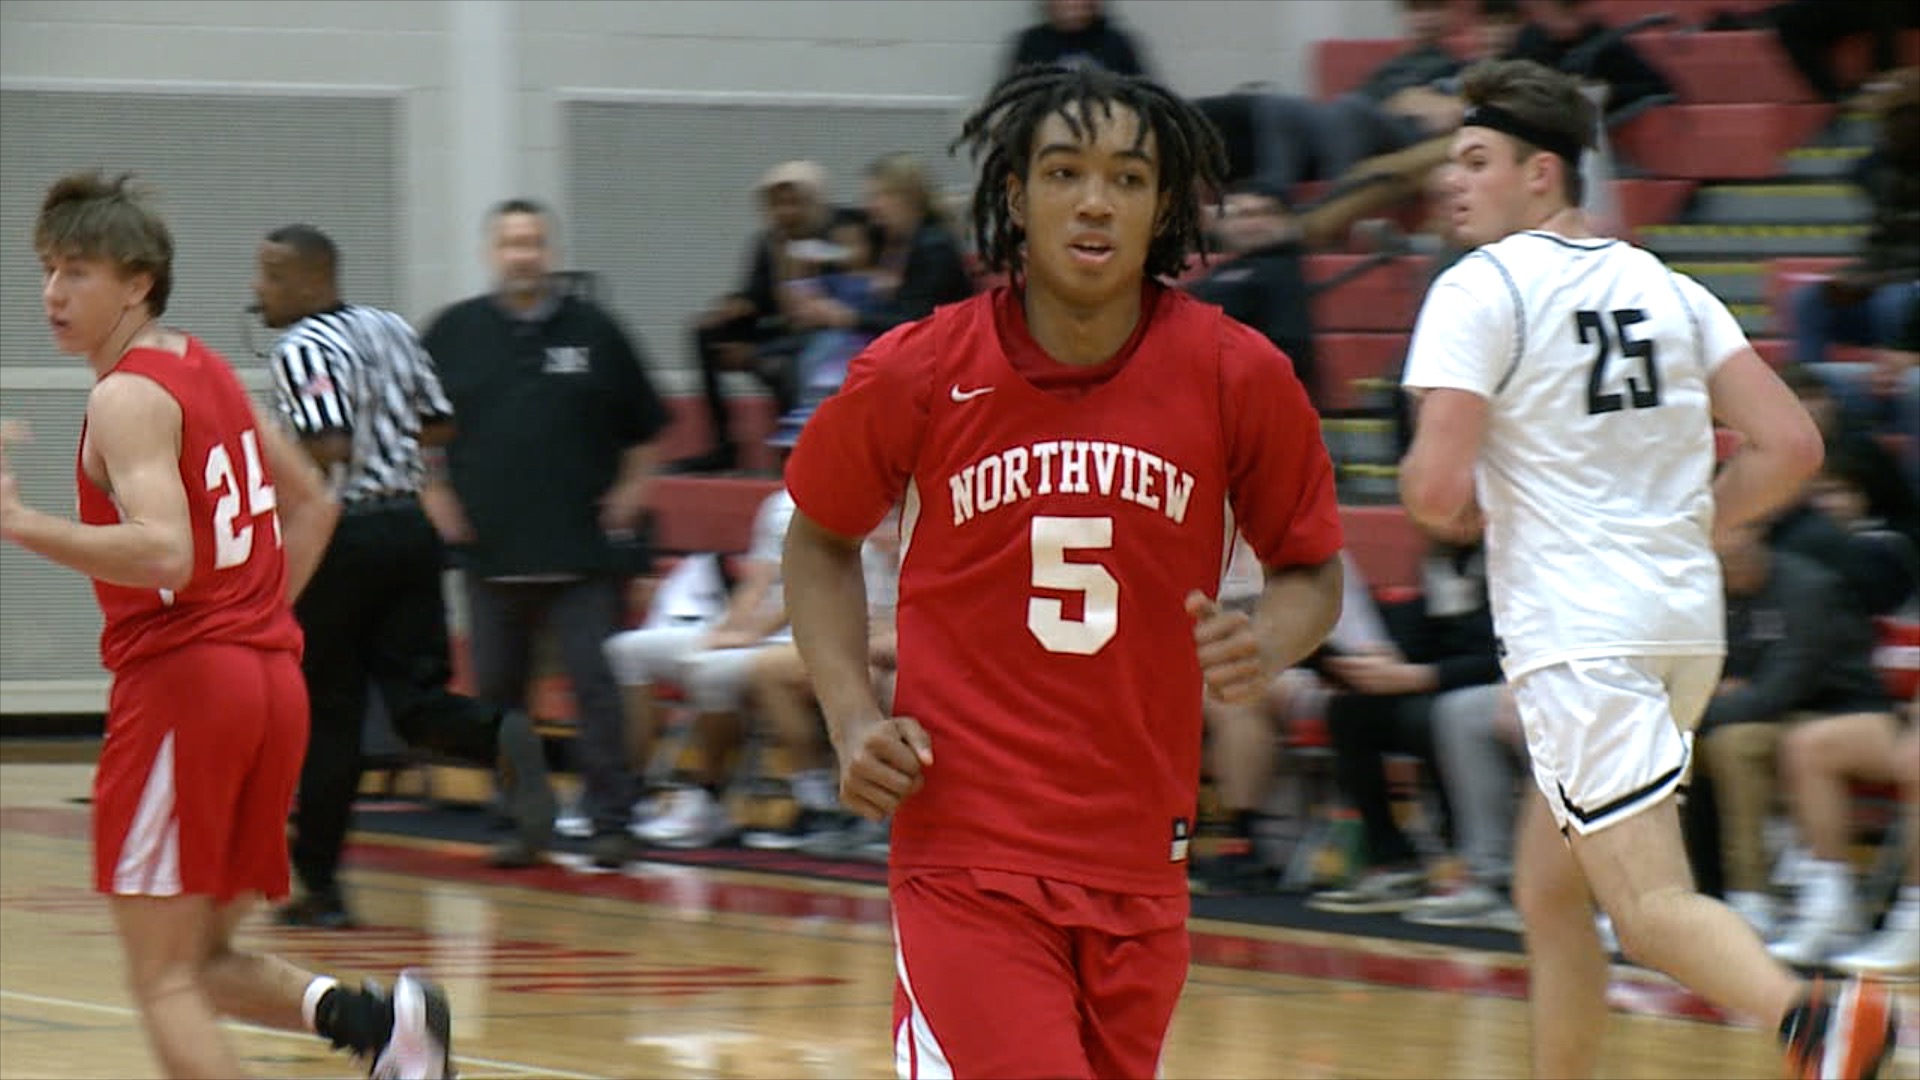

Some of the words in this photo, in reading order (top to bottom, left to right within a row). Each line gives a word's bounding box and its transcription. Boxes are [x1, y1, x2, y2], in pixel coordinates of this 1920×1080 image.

[1573, 308, 1660, 416] 25
[205, 429, 282, 569] 24
[949, 440, 1195, 527] NORTHVIEW
[1027, 516, 1119, 655] 5
